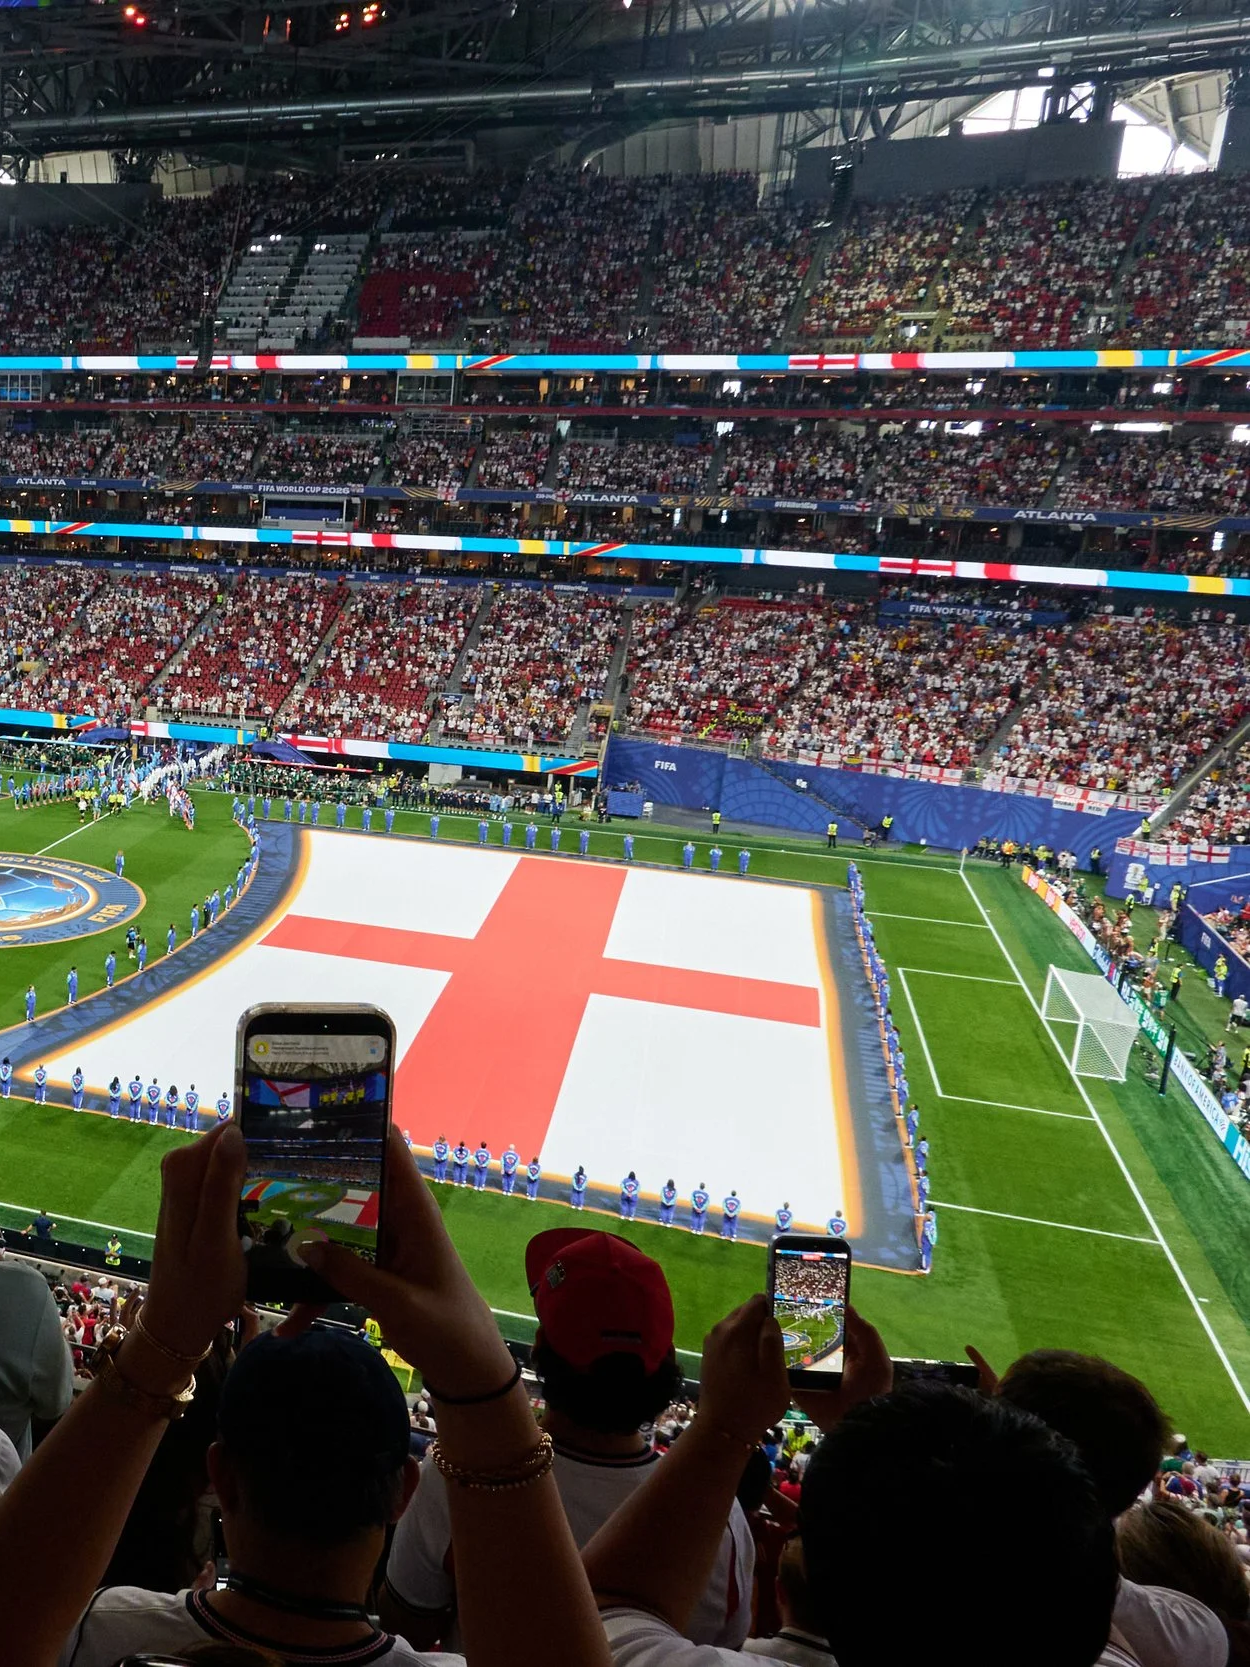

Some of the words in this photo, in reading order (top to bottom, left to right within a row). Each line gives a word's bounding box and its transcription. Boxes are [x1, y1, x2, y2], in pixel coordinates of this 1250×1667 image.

[16, 478, 66, 486] ATLANTA
[258, 484, 275, 492] FIFA
[277, 485, 304, 493] WORLD
[573, 493, 638, 503] ATLANTA
[1013, 510, 1097, 521] ATLANTA
[910, 604, 931, 614] FIFA
[654, 760, 677, 771] FIFA
[87, 904, 128, 923] FIFA
[1194, 1084, 1219, 1125] AMERICA
